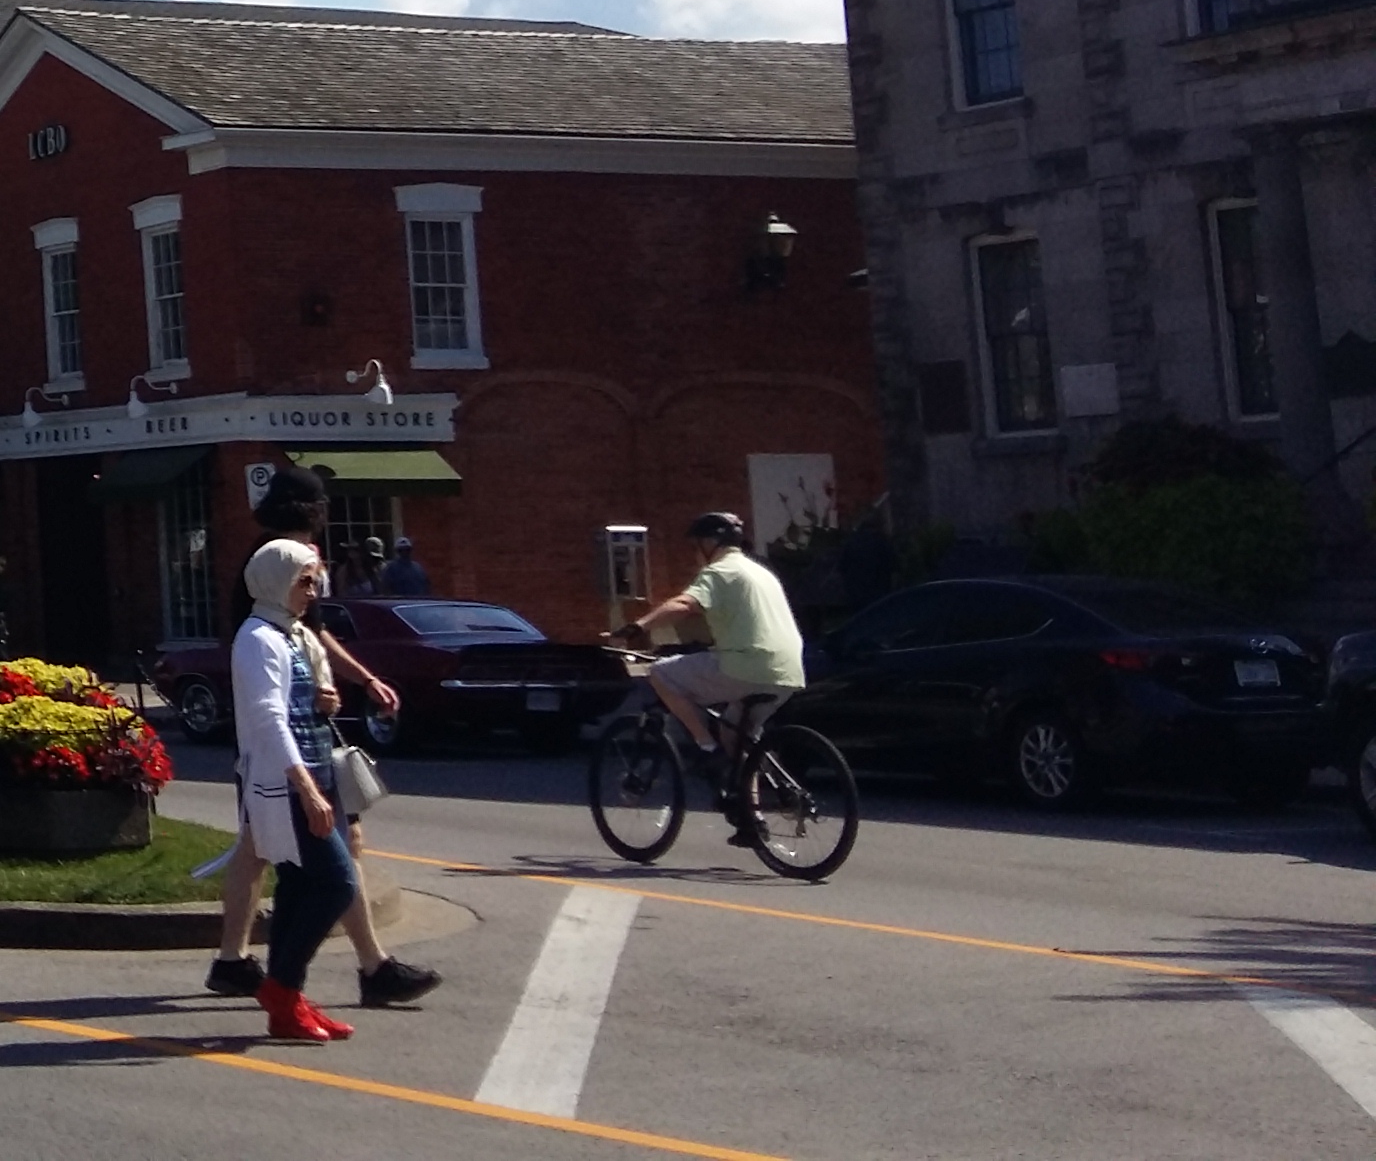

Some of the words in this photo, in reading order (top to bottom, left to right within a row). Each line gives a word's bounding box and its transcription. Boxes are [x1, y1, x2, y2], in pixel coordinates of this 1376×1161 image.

[27, 124, 68, 161] LCBO
[24, 426, 91, 445] SPIRITS
[145, 416, 189, 434] BEER
[269, 411, 351, 427] LIQUOR
[366, 411, 435, 427] STORE
